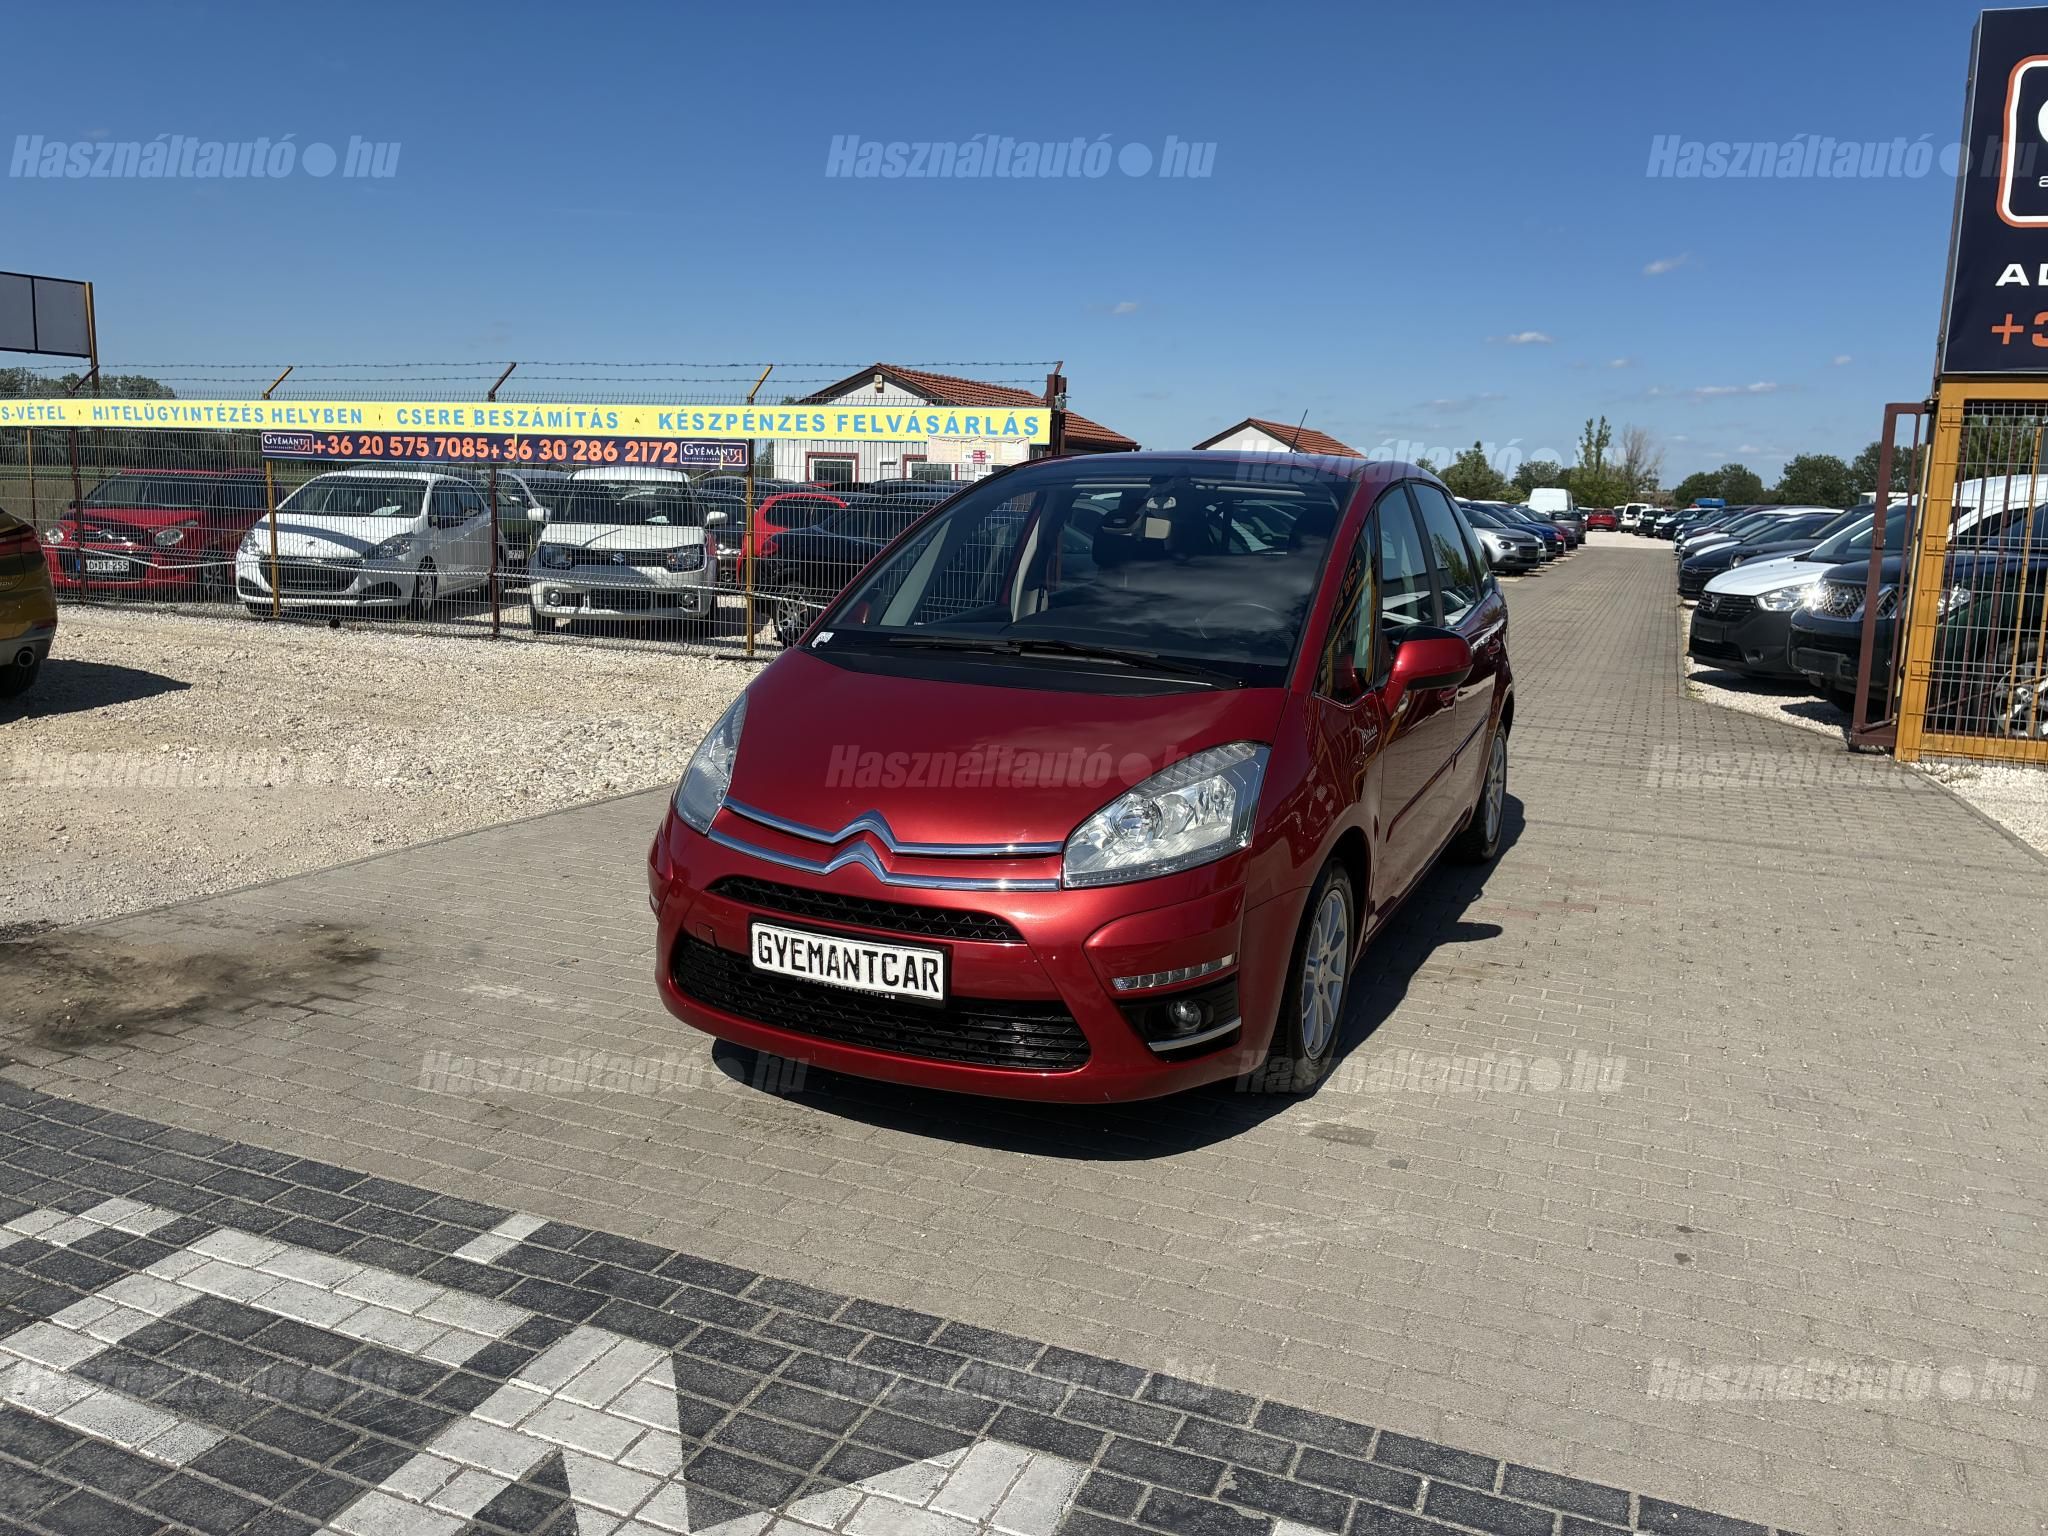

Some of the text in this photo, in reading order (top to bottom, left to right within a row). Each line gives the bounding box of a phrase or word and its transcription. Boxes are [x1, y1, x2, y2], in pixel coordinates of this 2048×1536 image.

[271, 407, 363, 424] HELYBEN
[396, 407, 619, 429] CSERE BESZÁMÍTÁS
[658, 409, 1039, 436] KÉSZPÉNZES FELVÁSÁRLÁS
[358, 435, 384, 456] 20
[389, 436, 431, 457] 575
[538, 439, 568, 461] 30
[572, 440, 618, 462] 286
[624, 441, 678, 464] 2172
[757, 931, 940, 993] GYEMANTCAR
